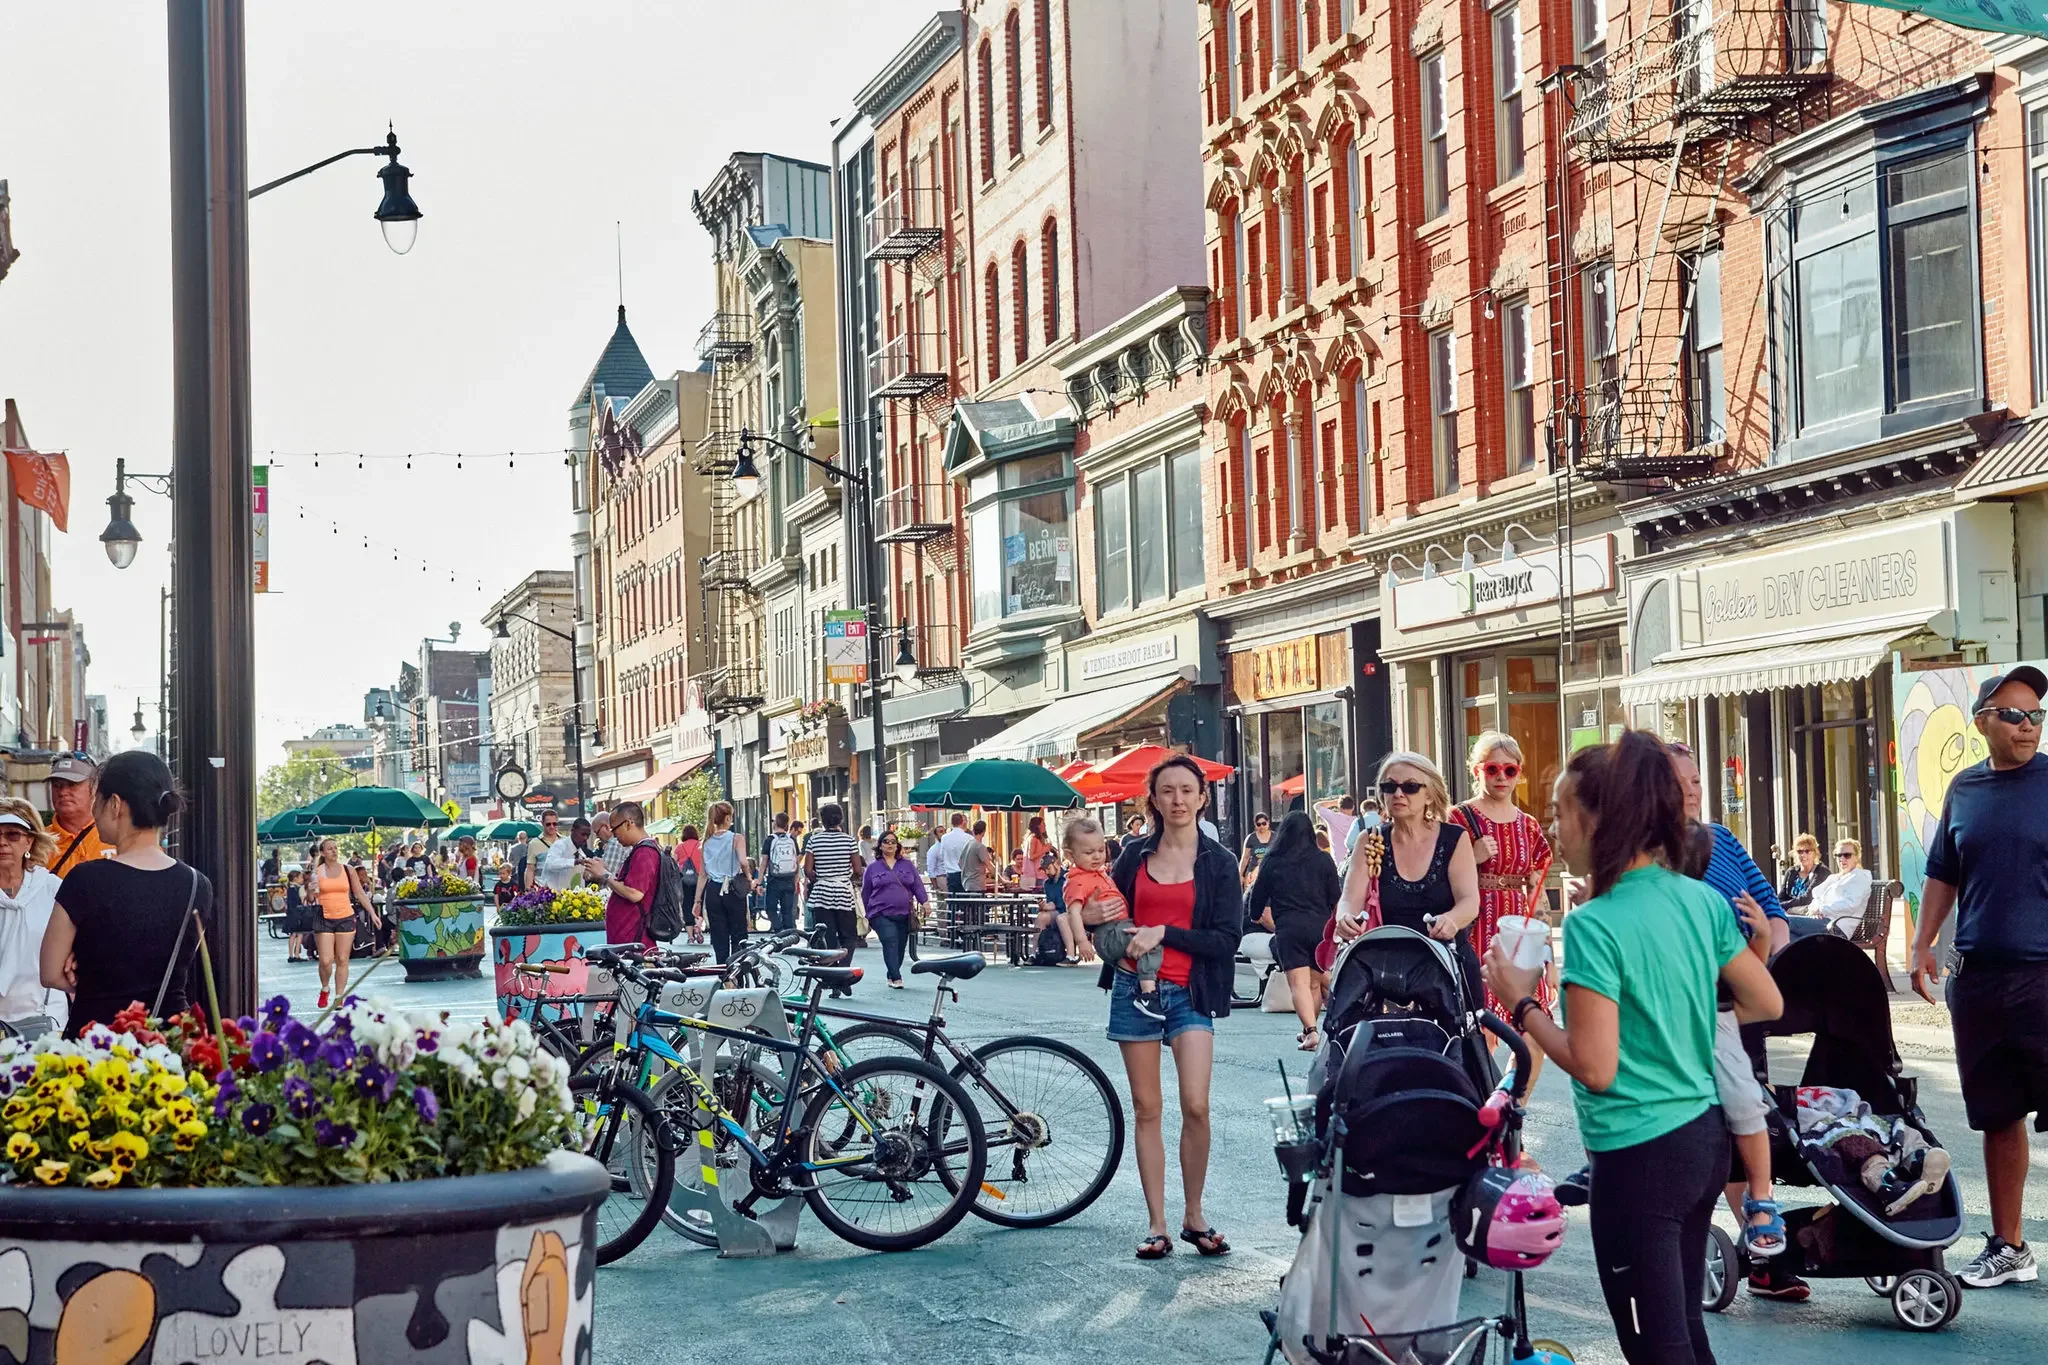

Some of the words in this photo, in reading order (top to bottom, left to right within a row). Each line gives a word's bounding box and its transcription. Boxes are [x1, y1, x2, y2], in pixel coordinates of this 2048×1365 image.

[1029, 539, 1058, 560] BERNI
[1476, 580, 1498, 603] H&R
[1499, 571, 1533, 598] BLOCK
[1703, 579, 1757, 636] Golden
[1763, 570, 1804, 619] DRY
[1807, 549, 1918, 612] CLEANERS
[828, 625, 844, 635] LIVE
[847, 624, 860, 635] EAT
[831, 666, 854, 679] WORK
[1090, 654, 1117, 673] TENDER
[1118, 648, 1141, 667] SHOOT
[1143, 643, 1163, 660] FARM
[1252, 640, 1315, 694] RAVAL
[1377, 1031, 1404, 1039] MACLAREN
[676, 1064, 729, 1120] GIANT
[193, 1321, 312, 1358] LOVELY
